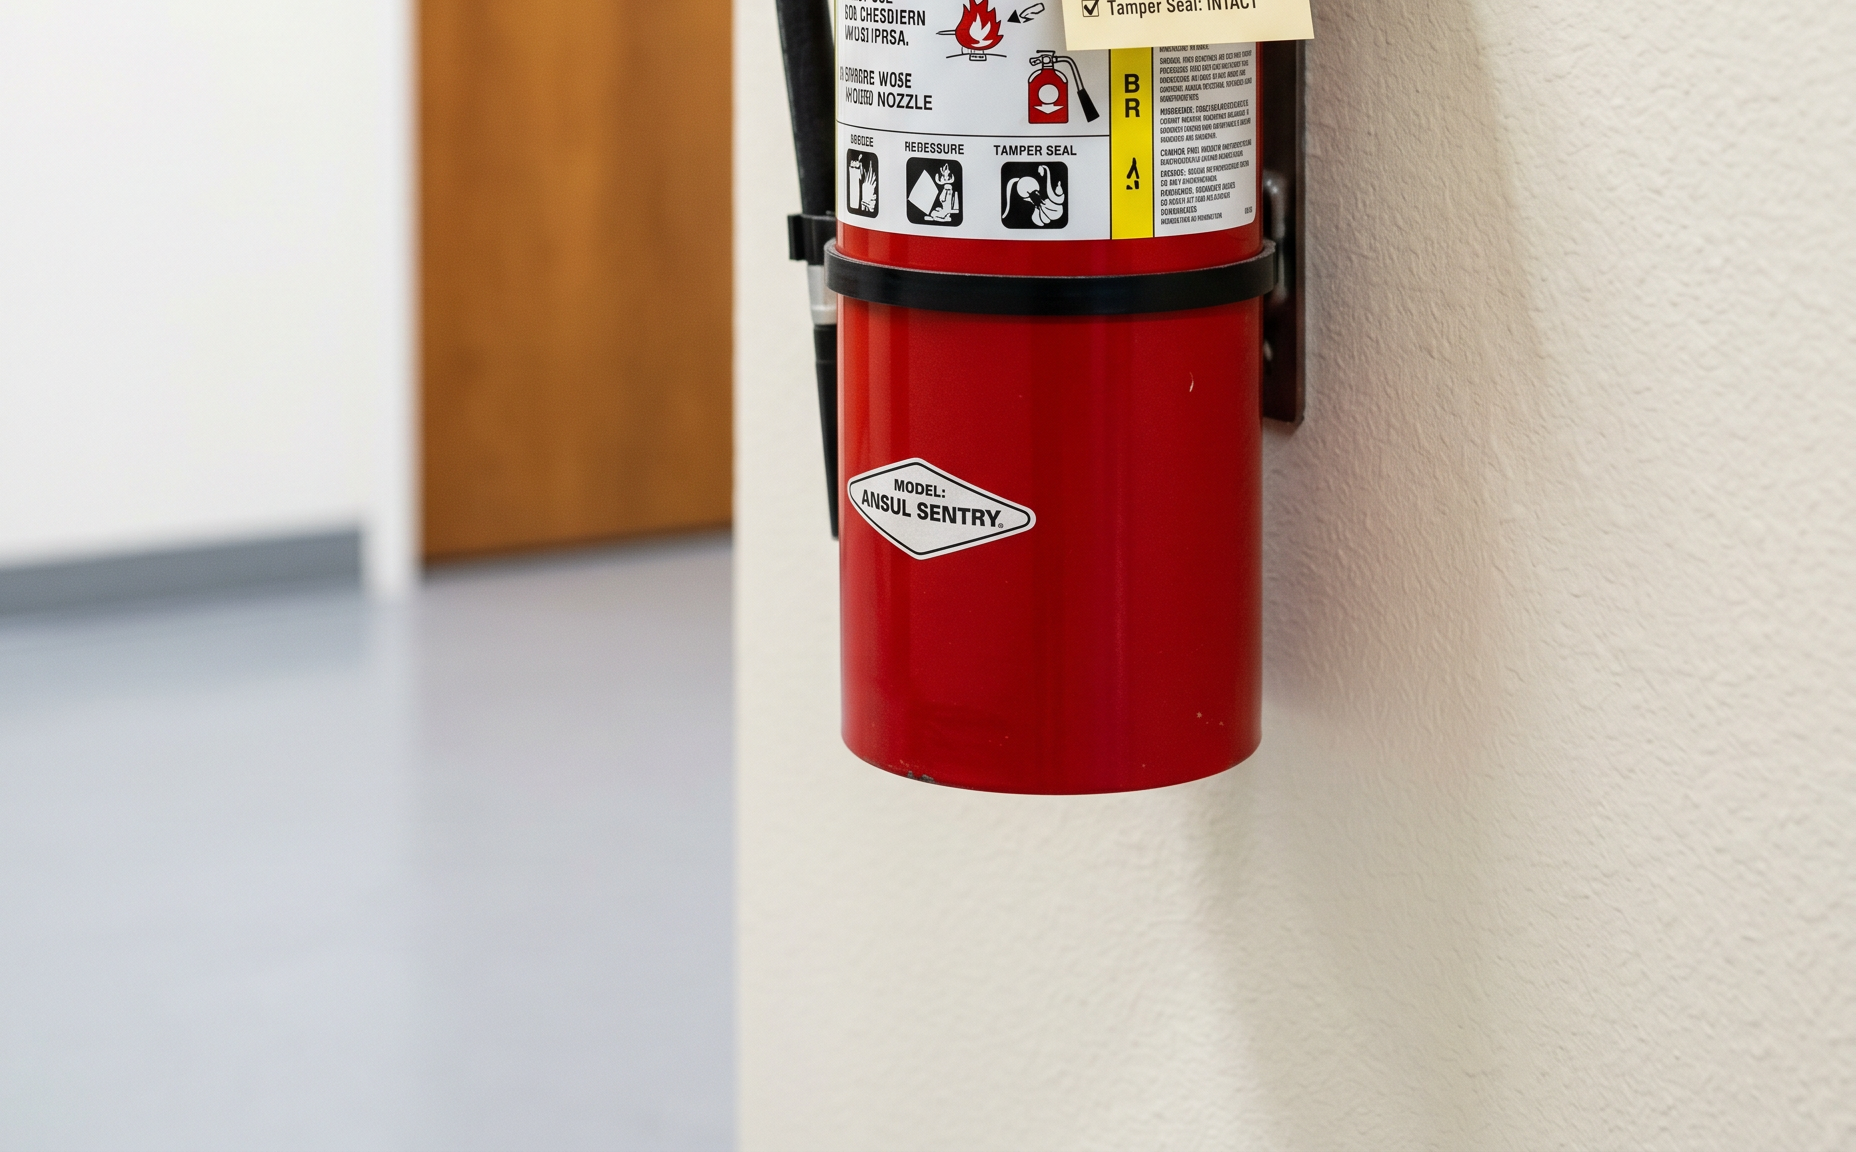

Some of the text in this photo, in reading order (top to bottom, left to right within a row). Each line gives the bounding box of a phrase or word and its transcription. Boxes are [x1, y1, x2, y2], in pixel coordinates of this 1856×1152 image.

[1107, 0, 1161, 18] Tamper
[878, 92, 932, 110] NOZZLE
[993, 144, 1077, 156] TAMPER SEAL
[894, 478, 946, 498] MODEL:
[861, 489, 911, 517] ANSUL
